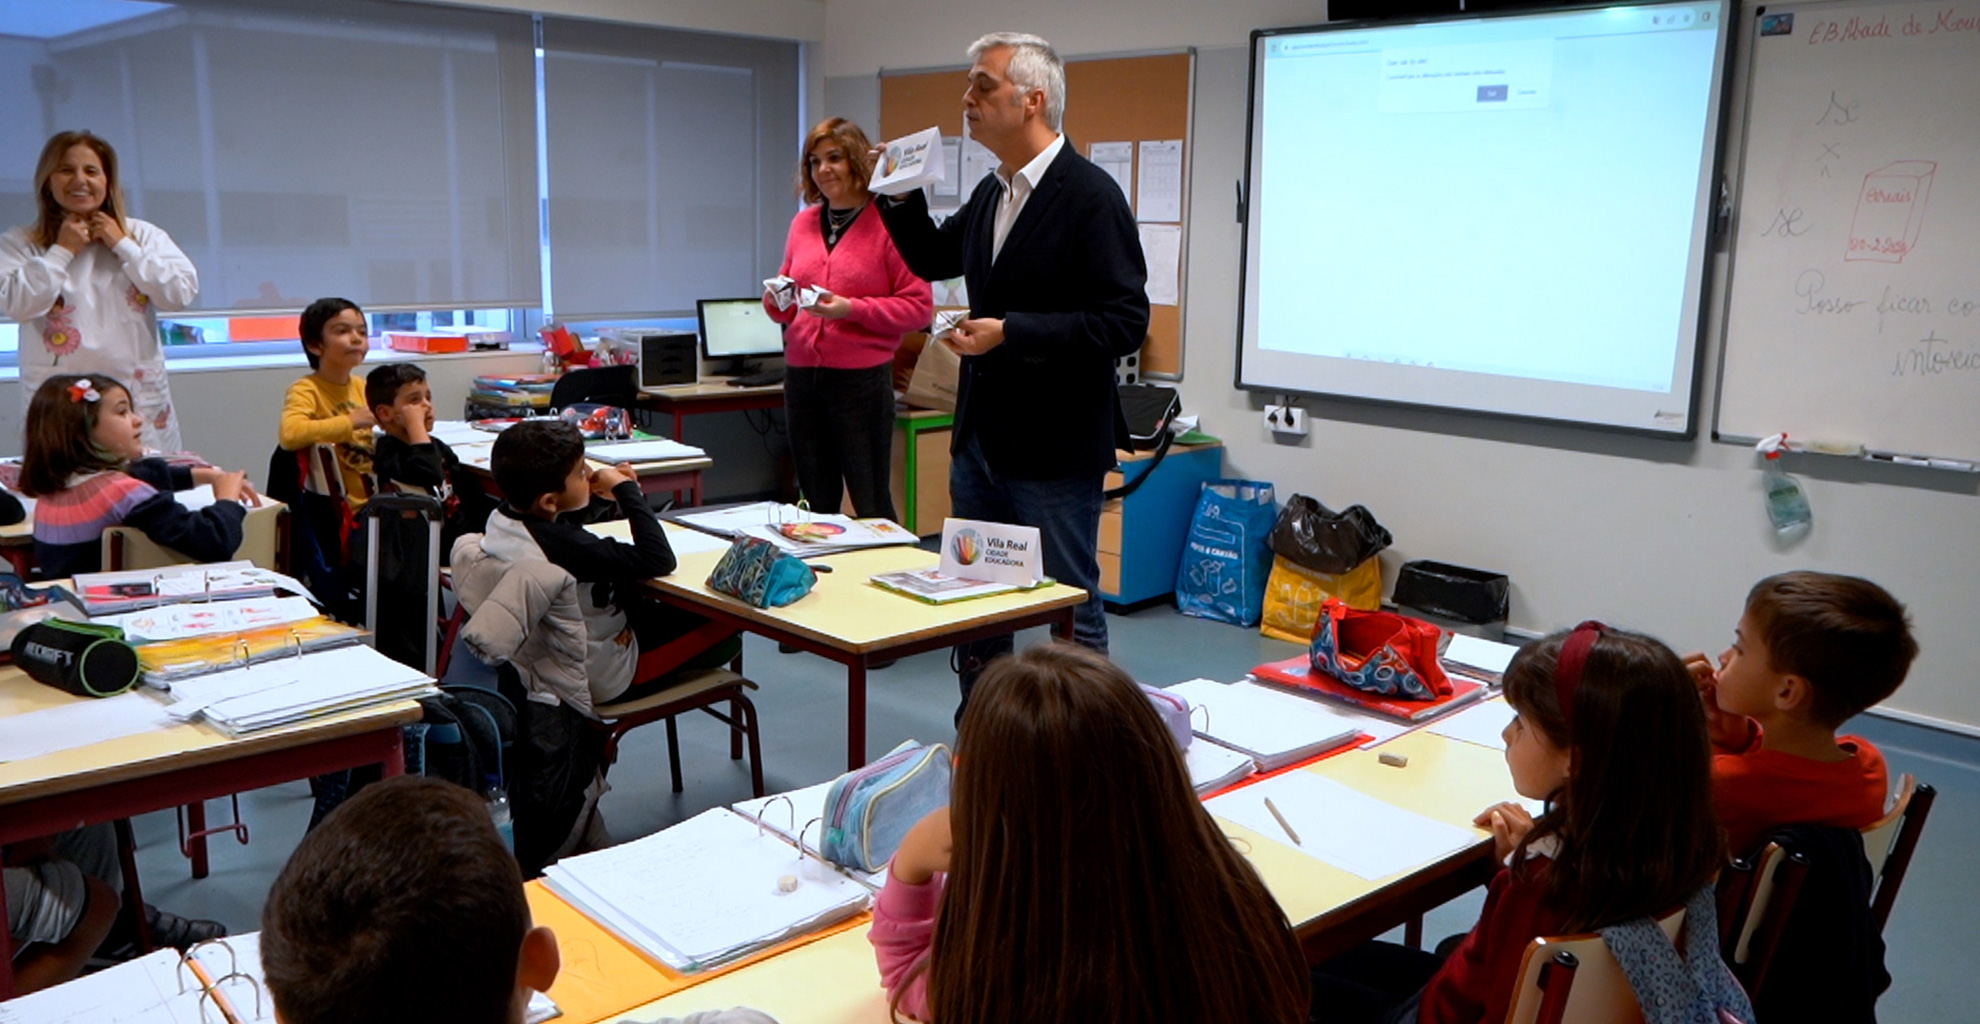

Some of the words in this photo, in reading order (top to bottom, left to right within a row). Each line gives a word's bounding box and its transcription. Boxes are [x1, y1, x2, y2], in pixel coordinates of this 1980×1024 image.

[1794, 269, 1865, 315] Posso
[1876, 285, 1932, 334] ficar
[987, 537, 1005, 549] Vila
[1007, 540, 1028, 551] Real
[985, 549, 1009, 558] CIDADE
[984, 557, 1024, 567] EDUCADORA
